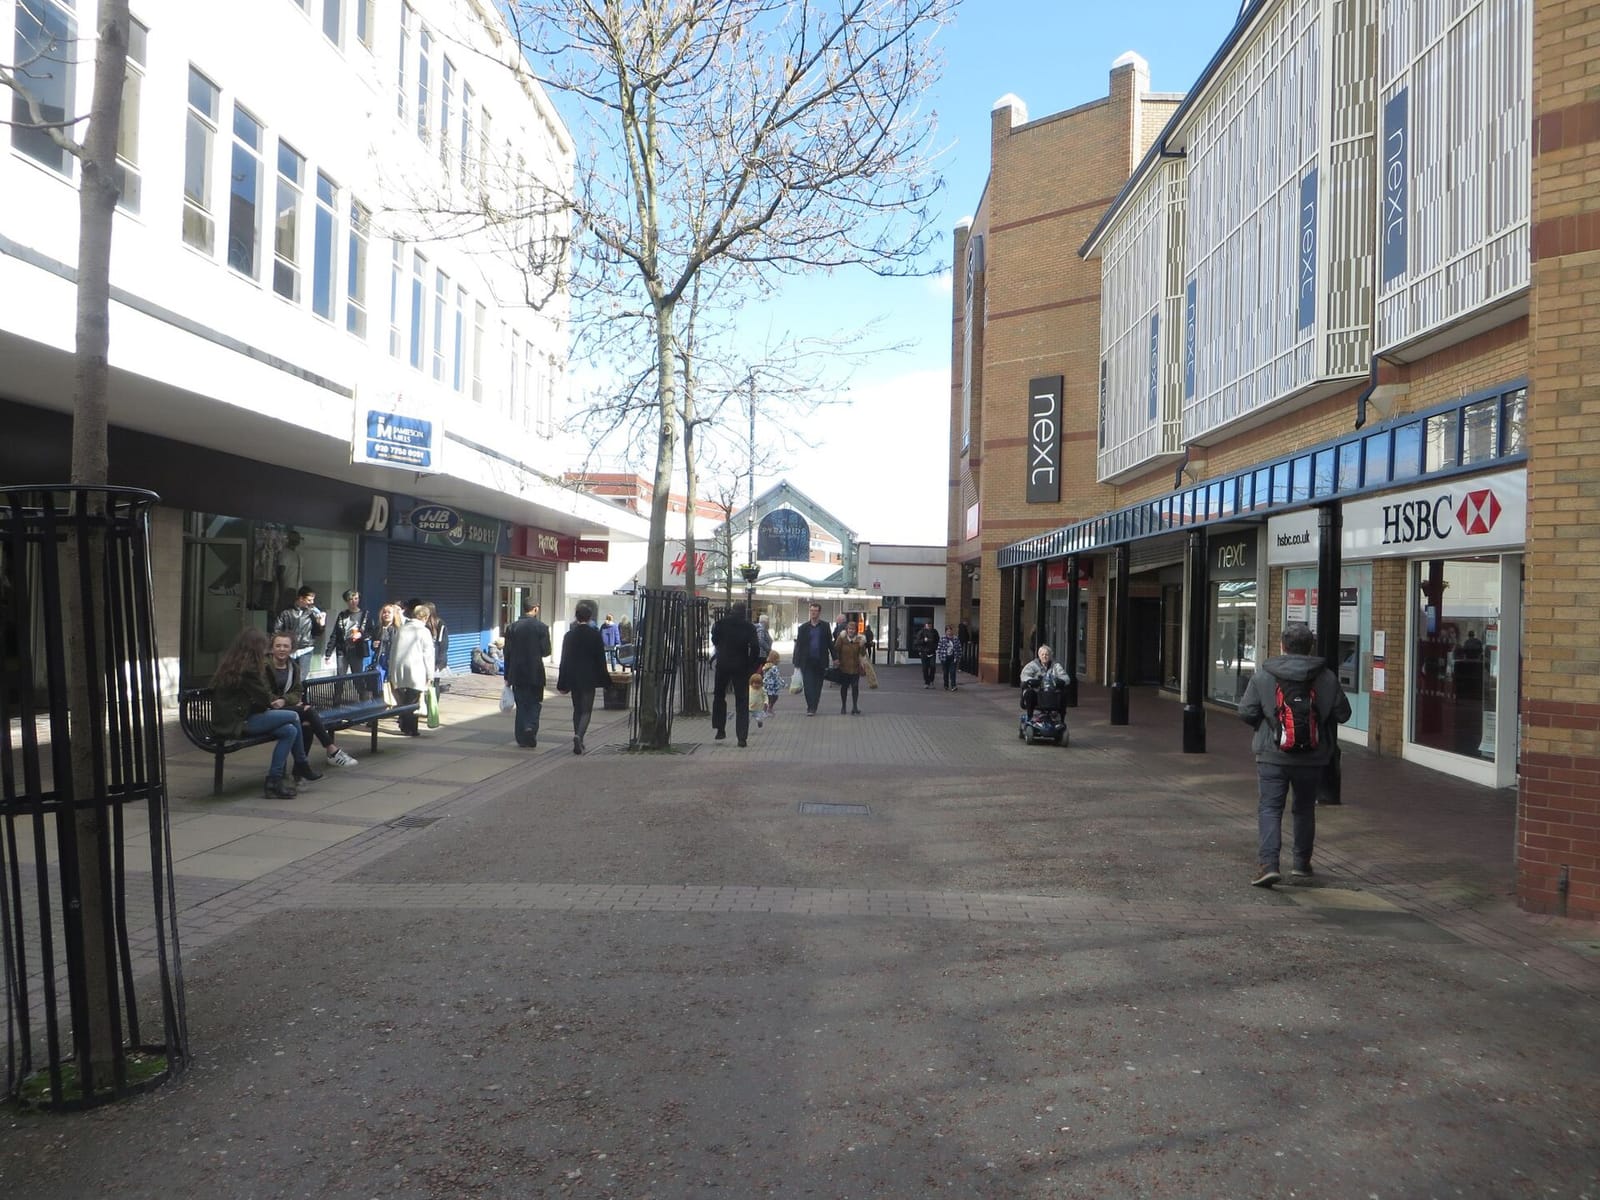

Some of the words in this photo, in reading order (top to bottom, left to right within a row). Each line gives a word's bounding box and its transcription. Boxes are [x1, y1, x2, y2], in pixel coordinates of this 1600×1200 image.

[1387, 127, 1403, 245] next
[1302, 200, 1314, 299] next
[1186, 303, 1196, 376] next
[1149, 333, 1159, 400] next
[1031, 393, 1055, 485] next
[365, 495, 389, 531] JD
[418, 510, 451, 522] JJB
[418, 522, 450, 530] SPORTS
[468, 525, 496, 544] SPORTS
[1382, 494, 1453, 545] HSBC
[1217, 542, 1247, 569] next
[1277, 529, 1311, 547] hsbc.co.uk
